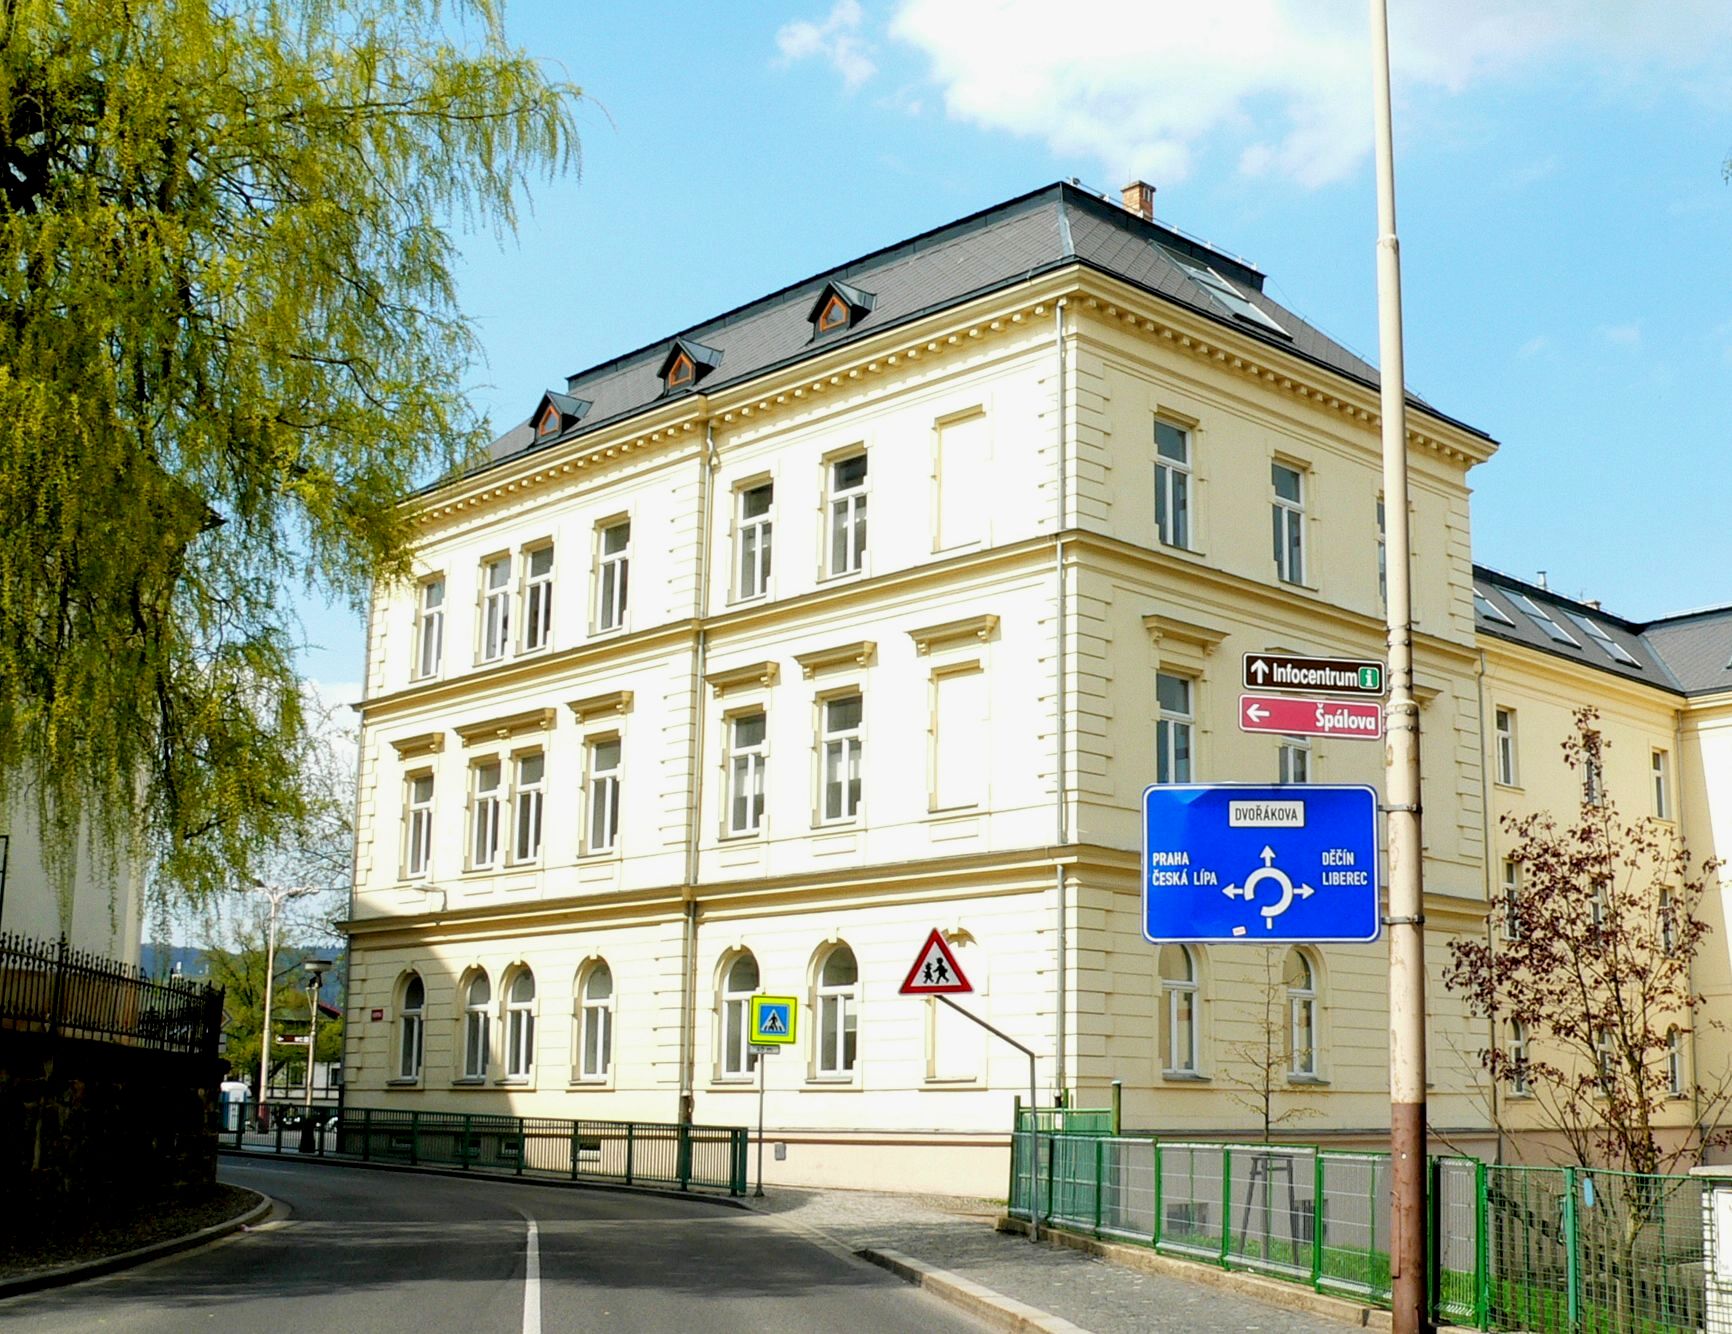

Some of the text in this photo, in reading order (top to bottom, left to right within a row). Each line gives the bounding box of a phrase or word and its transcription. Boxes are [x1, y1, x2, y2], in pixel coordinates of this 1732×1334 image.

[1272, 662, 1358, 687] Infocentrum
[1315, 702, 1376, 732] Špálova
[1235, 804, 1298, 821] DVOŘÁKOVA
[1152, 851, 1190, 866] PRAHA
[1322, 848, 1355, 866] DĚČÍN
[1152, 868, 1218, 886] ČESKÁ LÍPA
[1322, 871, 1368, 886] LIBEREC
